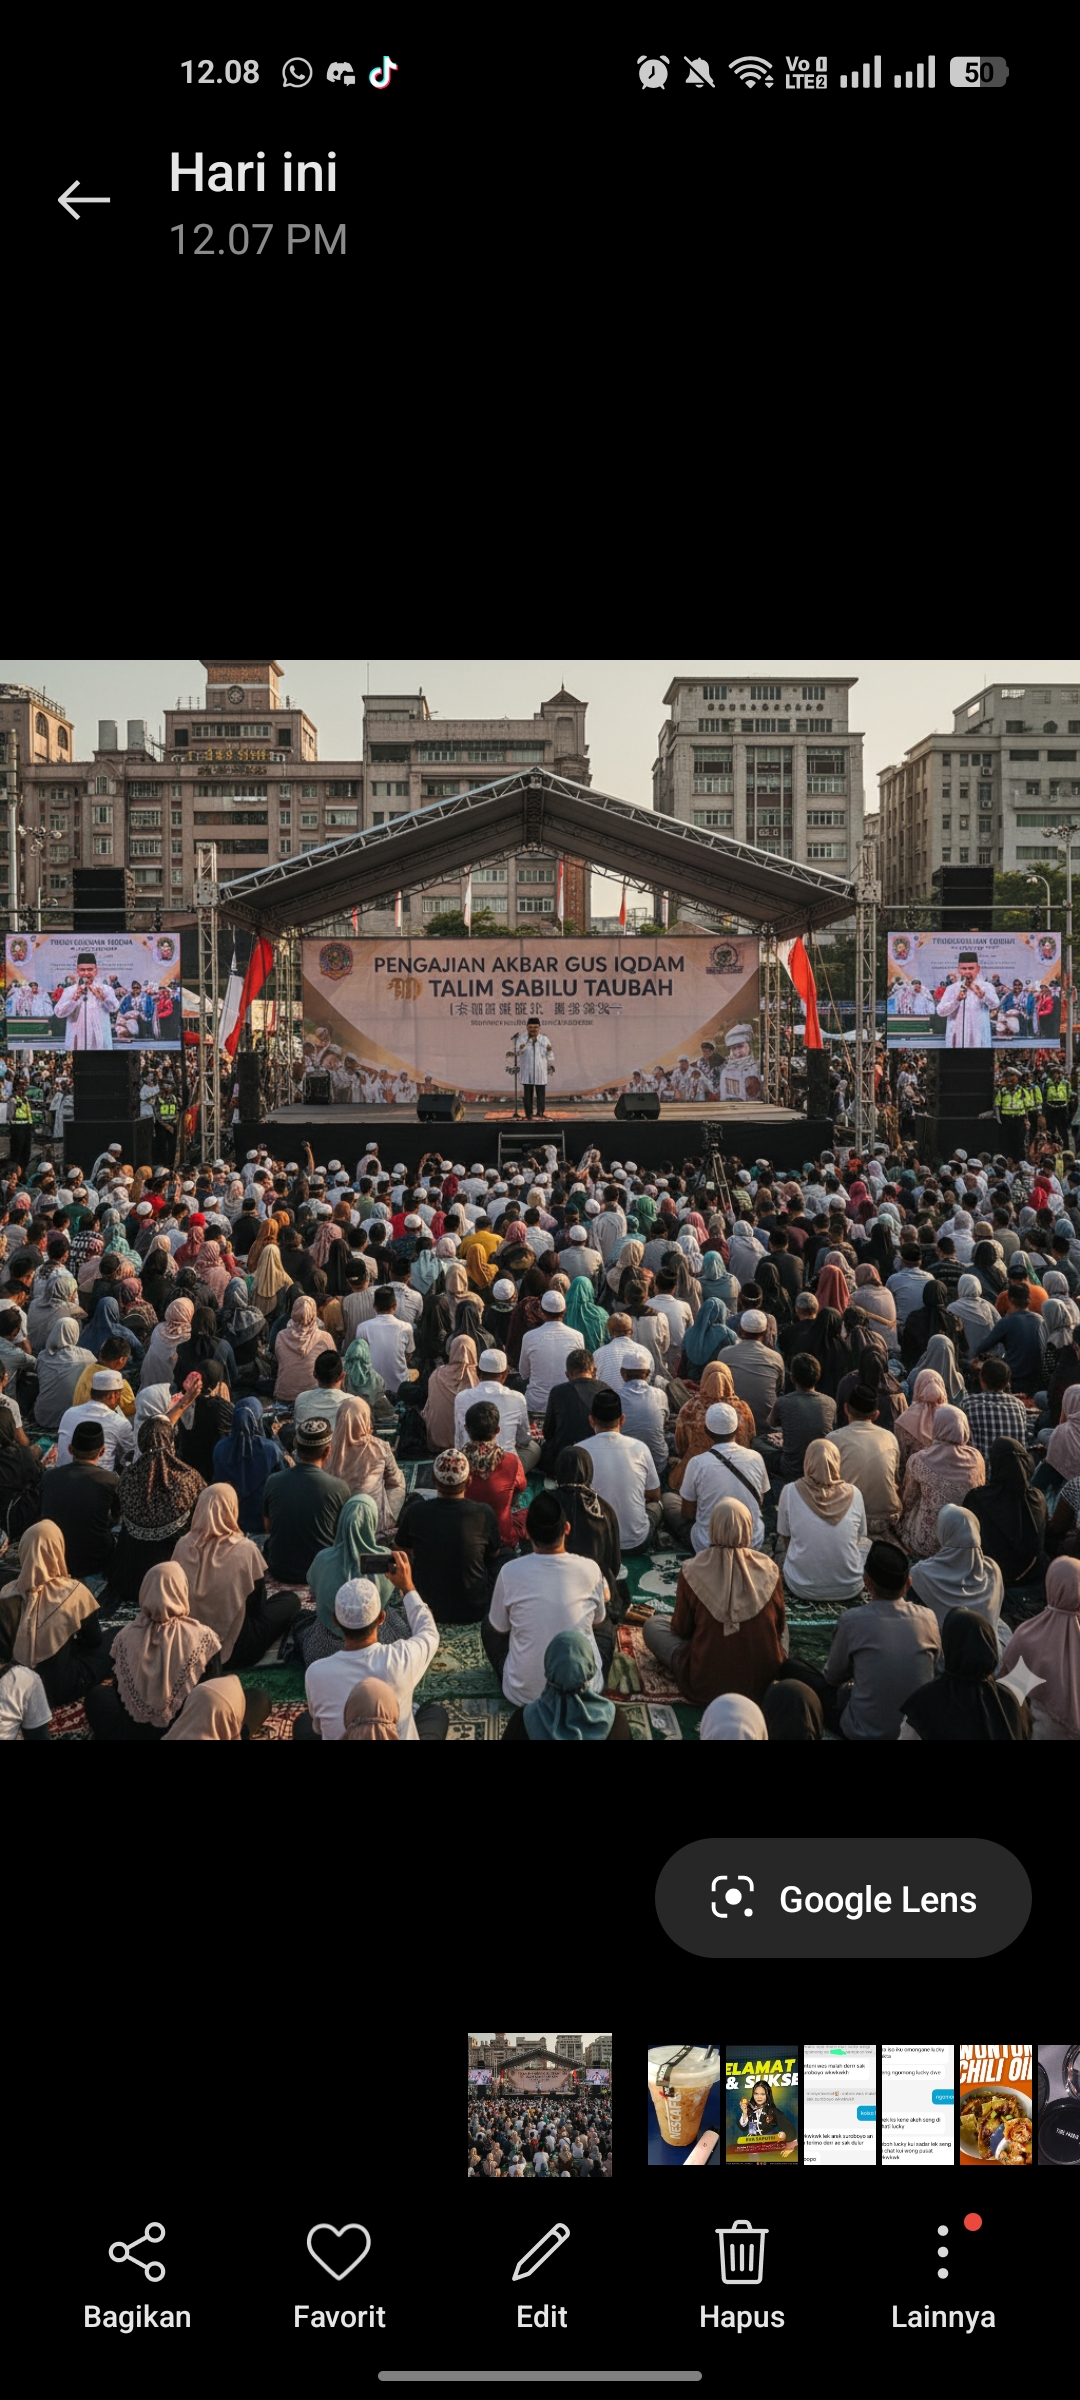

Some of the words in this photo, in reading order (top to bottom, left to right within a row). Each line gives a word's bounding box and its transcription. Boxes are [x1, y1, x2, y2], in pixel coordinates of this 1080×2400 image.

[181, 60, 259, 83] 12.08
[786, 56, 810, 71] Vo
[965, 62, 994, 83] 50
[172, 151, 265, 192] Hari
[284, 151, 336, 192] ini
[171, 224, 273, 255] 12.07
[288, 224, 345, 254] PM
[374, 957, 485, 973] PENGAJIAN
[491, 957, 559, 973] AKBAR
[565, 956, 608, 973] GUS
[615, 956, 685, 974] IQDAM
[428, 979, 493, 997] TALIM
[501, 979, 578, 997] SABILU
[584, 979, 673, 997] TAUBAH
[781, 1885, 891, 1921] Google
[903, 1886, 976, 1914] Lens
[726, 2059, 796, 2075] ELAMAT
[960, 2057, 1004, 2084] CHILI
[726, 2076, 739, 2090] &
[85, 2304, 191, 2334] Bagikan
[294, 2304, 386, 2328] Favorit
[517, 2304, 568, 2328] Edit
[700, 2304, 785, 2334] Hapus
[892, 2304, 996, 2335] Lainnya
